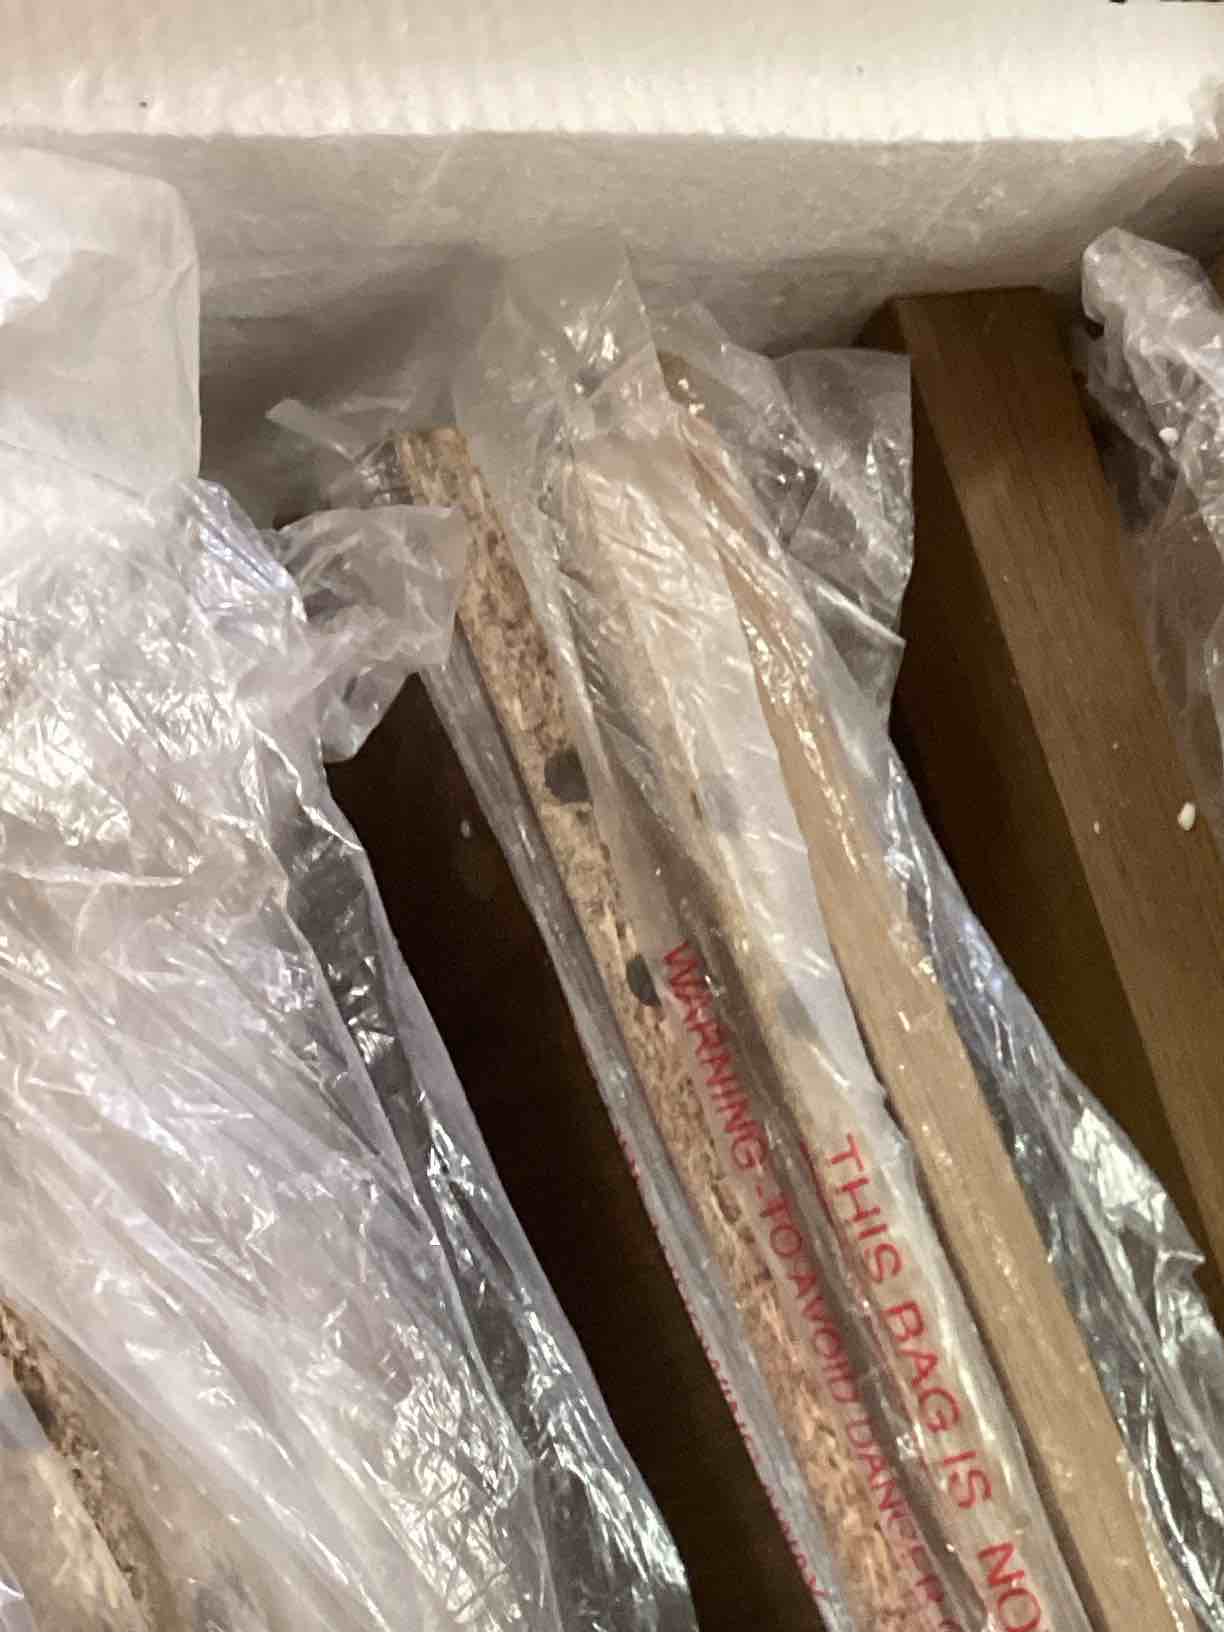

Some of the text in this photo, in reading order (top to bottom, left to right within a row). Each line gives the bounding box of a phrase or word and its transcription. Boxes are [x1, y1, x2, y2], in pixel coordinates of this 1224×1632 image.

[662, 940, 771, 1170] WARNING
[793, 1270, 862, 1404] AVOID
[827, 1133, 904, 1284] THIS
[883, 1301, 961, 1434] BAG
[942, 1449, 993, 1511] IS
